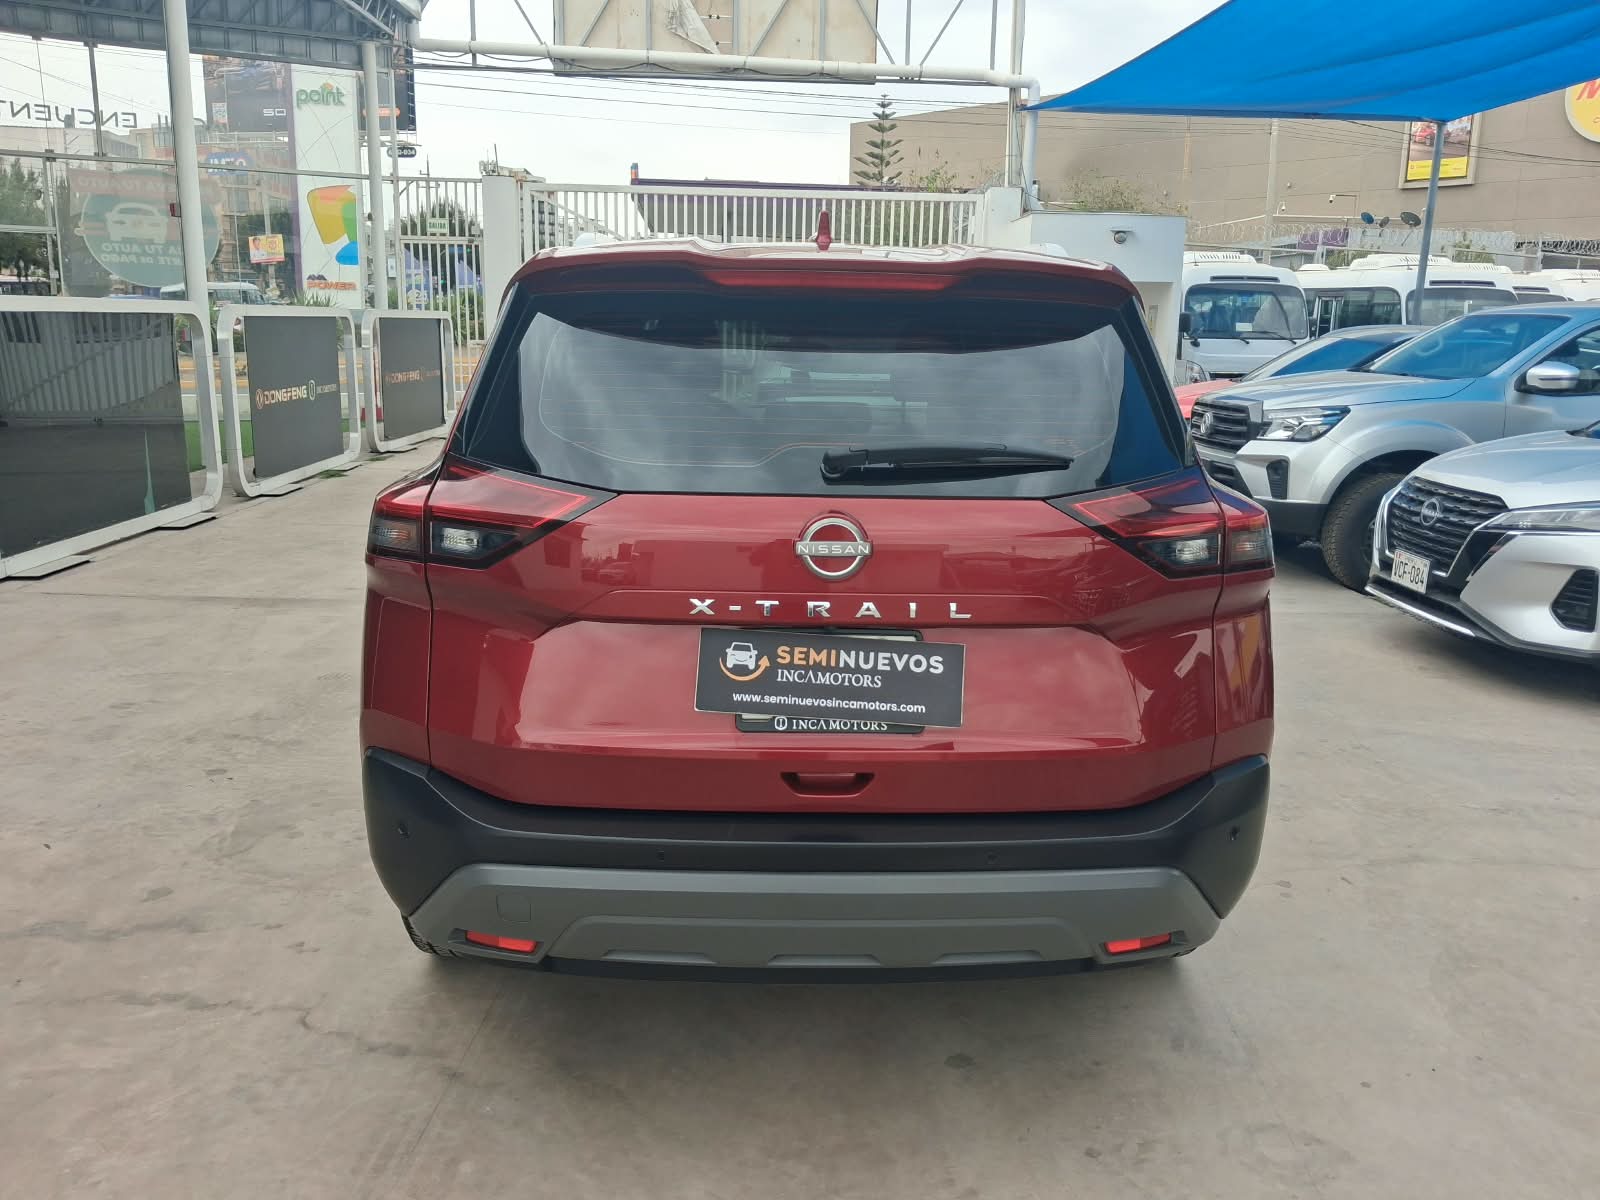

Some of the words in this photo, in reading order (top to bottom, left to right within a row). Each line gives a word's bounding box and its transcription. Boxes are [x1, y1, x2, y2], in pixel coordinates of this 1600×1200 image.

[296, 83, 344, 110] point
[428, 221, 447, 230] SALIDA
[307, 280, 356, 290] POWER
[263, 385, 308, 404] DONGFENG
[798, 543, 870, 554] NISSAN
[1394, 560, 1425, 586] VCF-084
[689, 598, 971, 619] X-TRAIL
[776, 645, 944, 674] SEMINUEVOS
[776, 669, 882, 688] INCAMOTORS
[732, 692, 926, 713] www.seminuevosincamotors.com
